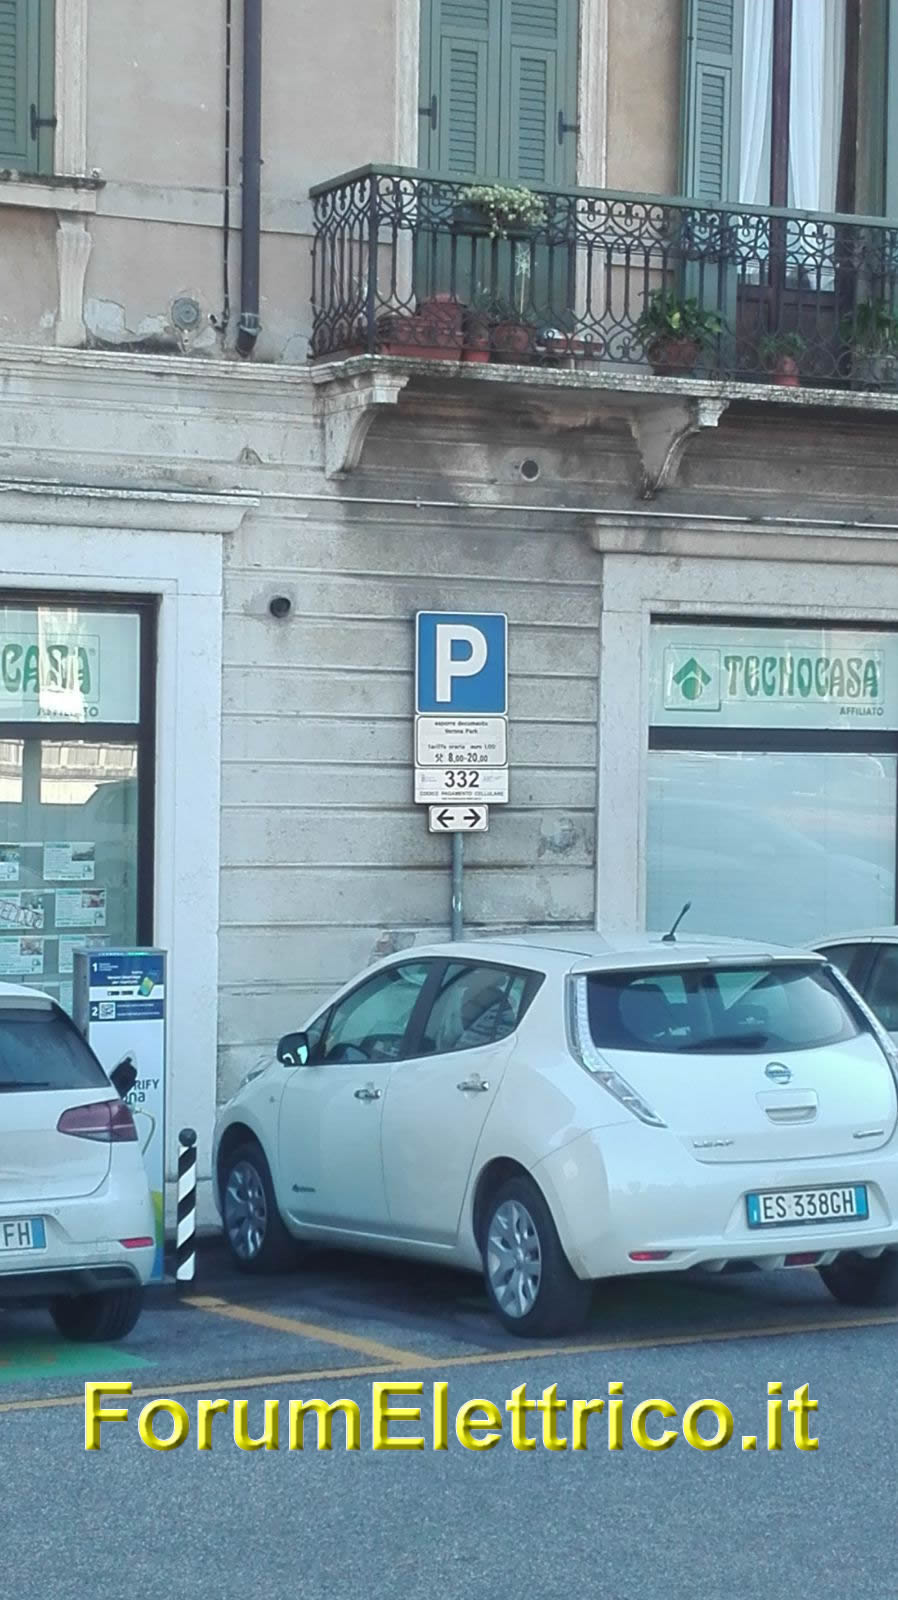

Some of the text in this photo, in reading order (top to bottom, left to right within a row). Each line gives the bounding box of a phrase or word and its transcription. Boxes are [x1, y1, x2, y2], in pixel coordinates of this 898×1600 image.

[436, 624, 488, 702] P
[724, 655, 879, 698] TECNOCASA
[840, 707, 884, 717] AFFILIATO
[444, 770, 480, 788] 332
[92, 962, 98, 972] 1
[91, 1006, 98, 1016] 2
[763, 1190, 855, 1219] ES 338GH
[3, 1222, 31, 1247] FH
